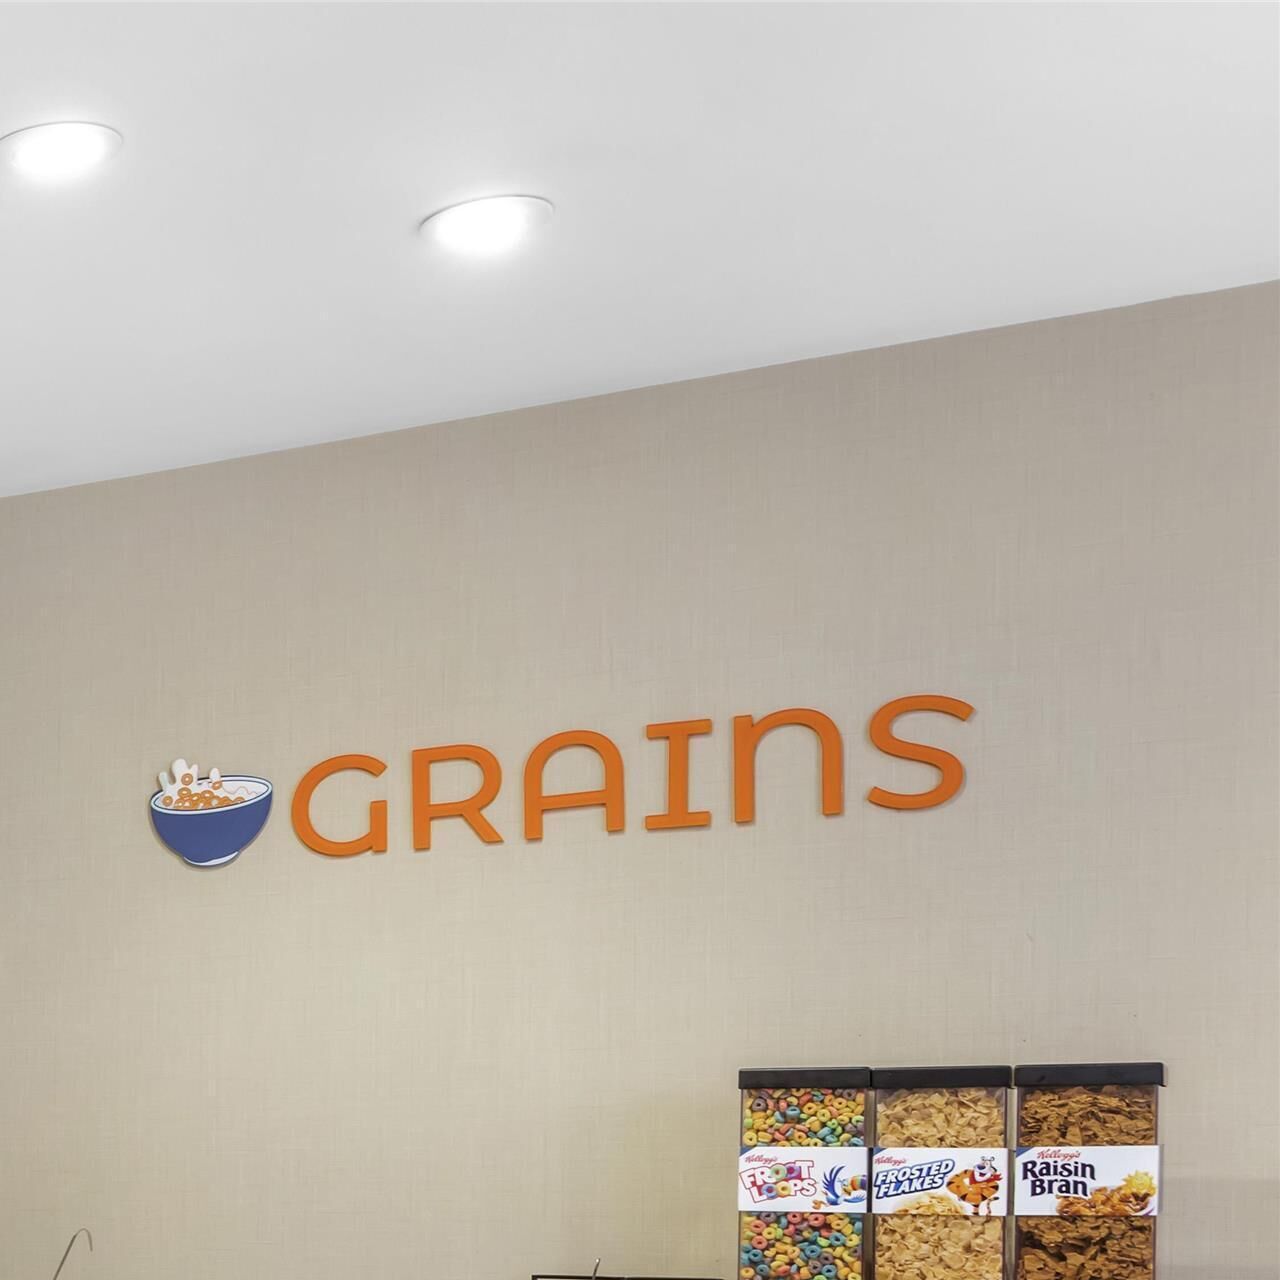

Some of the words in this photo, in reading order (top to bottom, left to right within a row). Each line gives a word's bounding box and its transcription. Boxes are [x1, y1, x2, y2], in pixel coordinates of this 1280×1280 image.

[290, 693, 977, 857] GRAINS
[744, 1153, 778, 1164] Kellogg's
[874, 1156, 908, 1166] Kellogg's
[1036, 1149, 1081, 1161] Kellogg's
[739, 1159, 815, 1190] FROOT
[875, 1159, 956, 1186] FROSTED
[1022, 1160, 1096, 1181] Raisin
[749, 1178, 817, 1204] LOOPS
[875, 1174, 948, 1199] FLAKES
[1030, 1178, 1089, 1198] Bran
